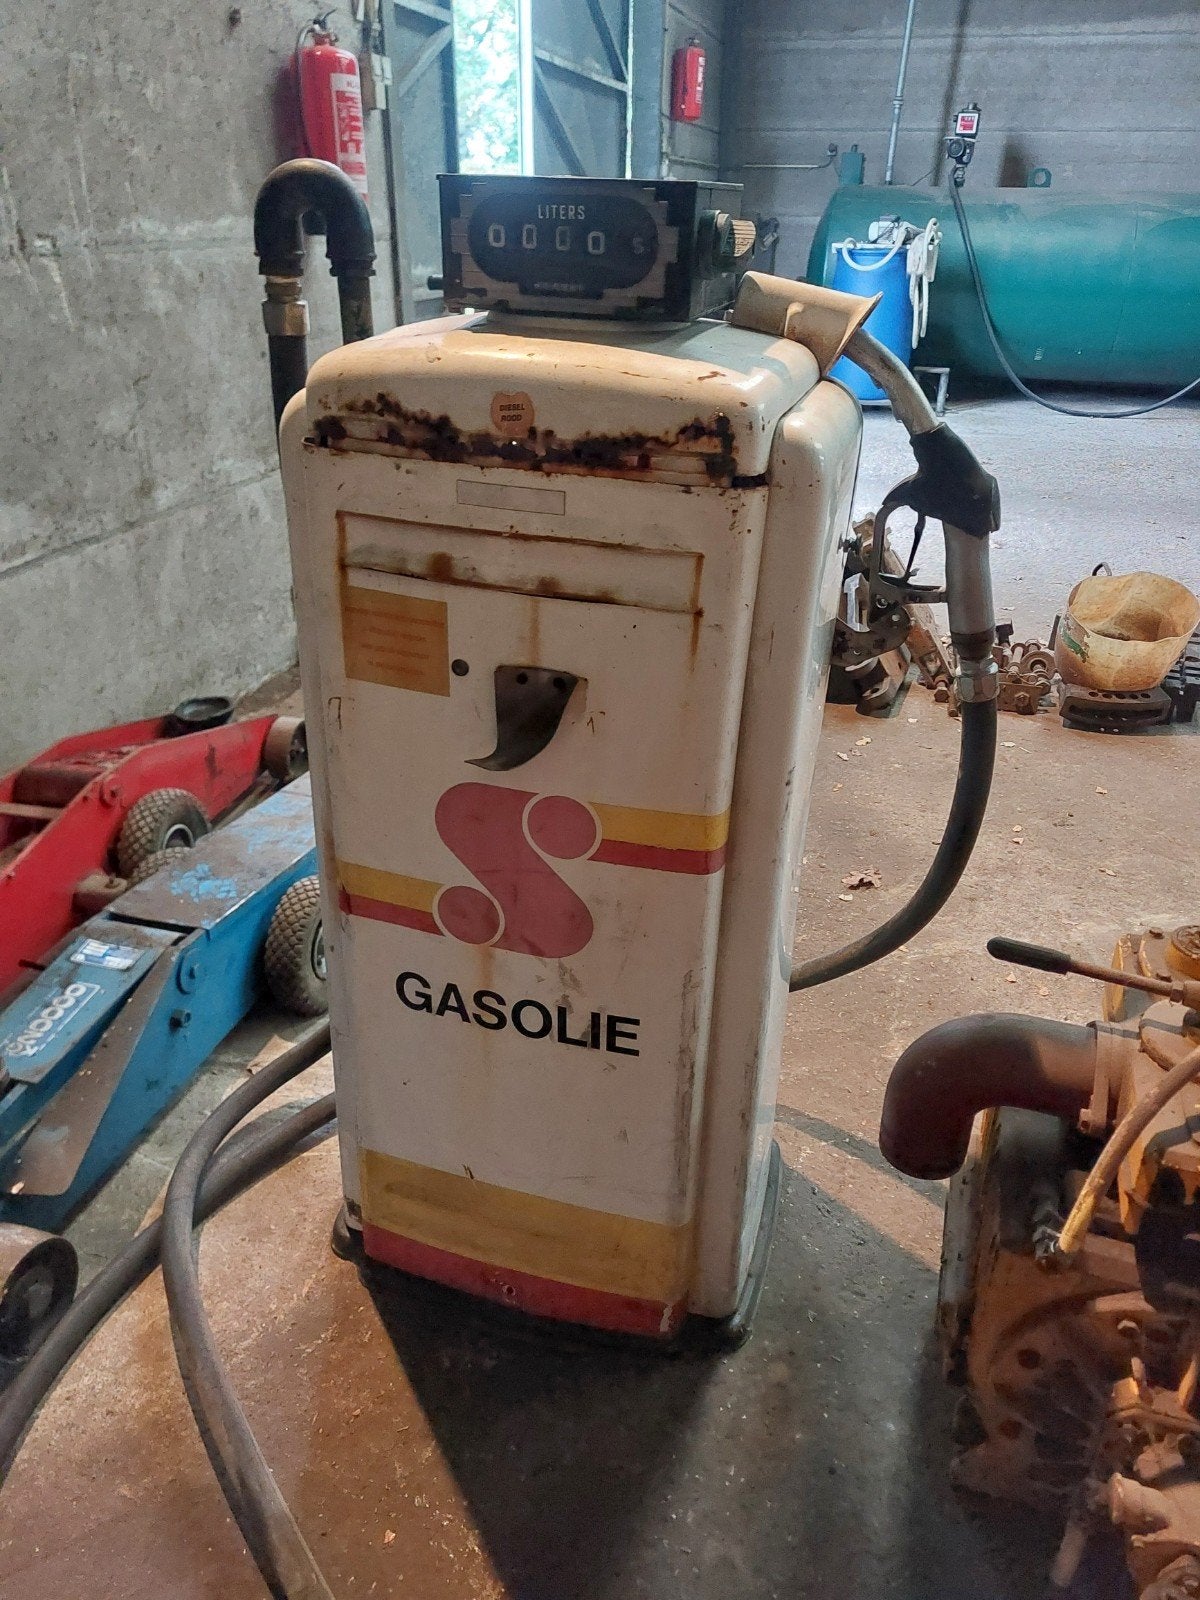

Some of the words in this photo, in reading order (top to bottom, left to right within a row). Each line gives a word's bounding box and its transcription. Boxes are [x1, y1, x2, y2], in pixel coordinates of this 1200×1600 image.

[538, 204, 586, 220] LITERS
[499, 403, 525, 411] DIESEL
[395, 971, 641, 1057] GASOLIE
